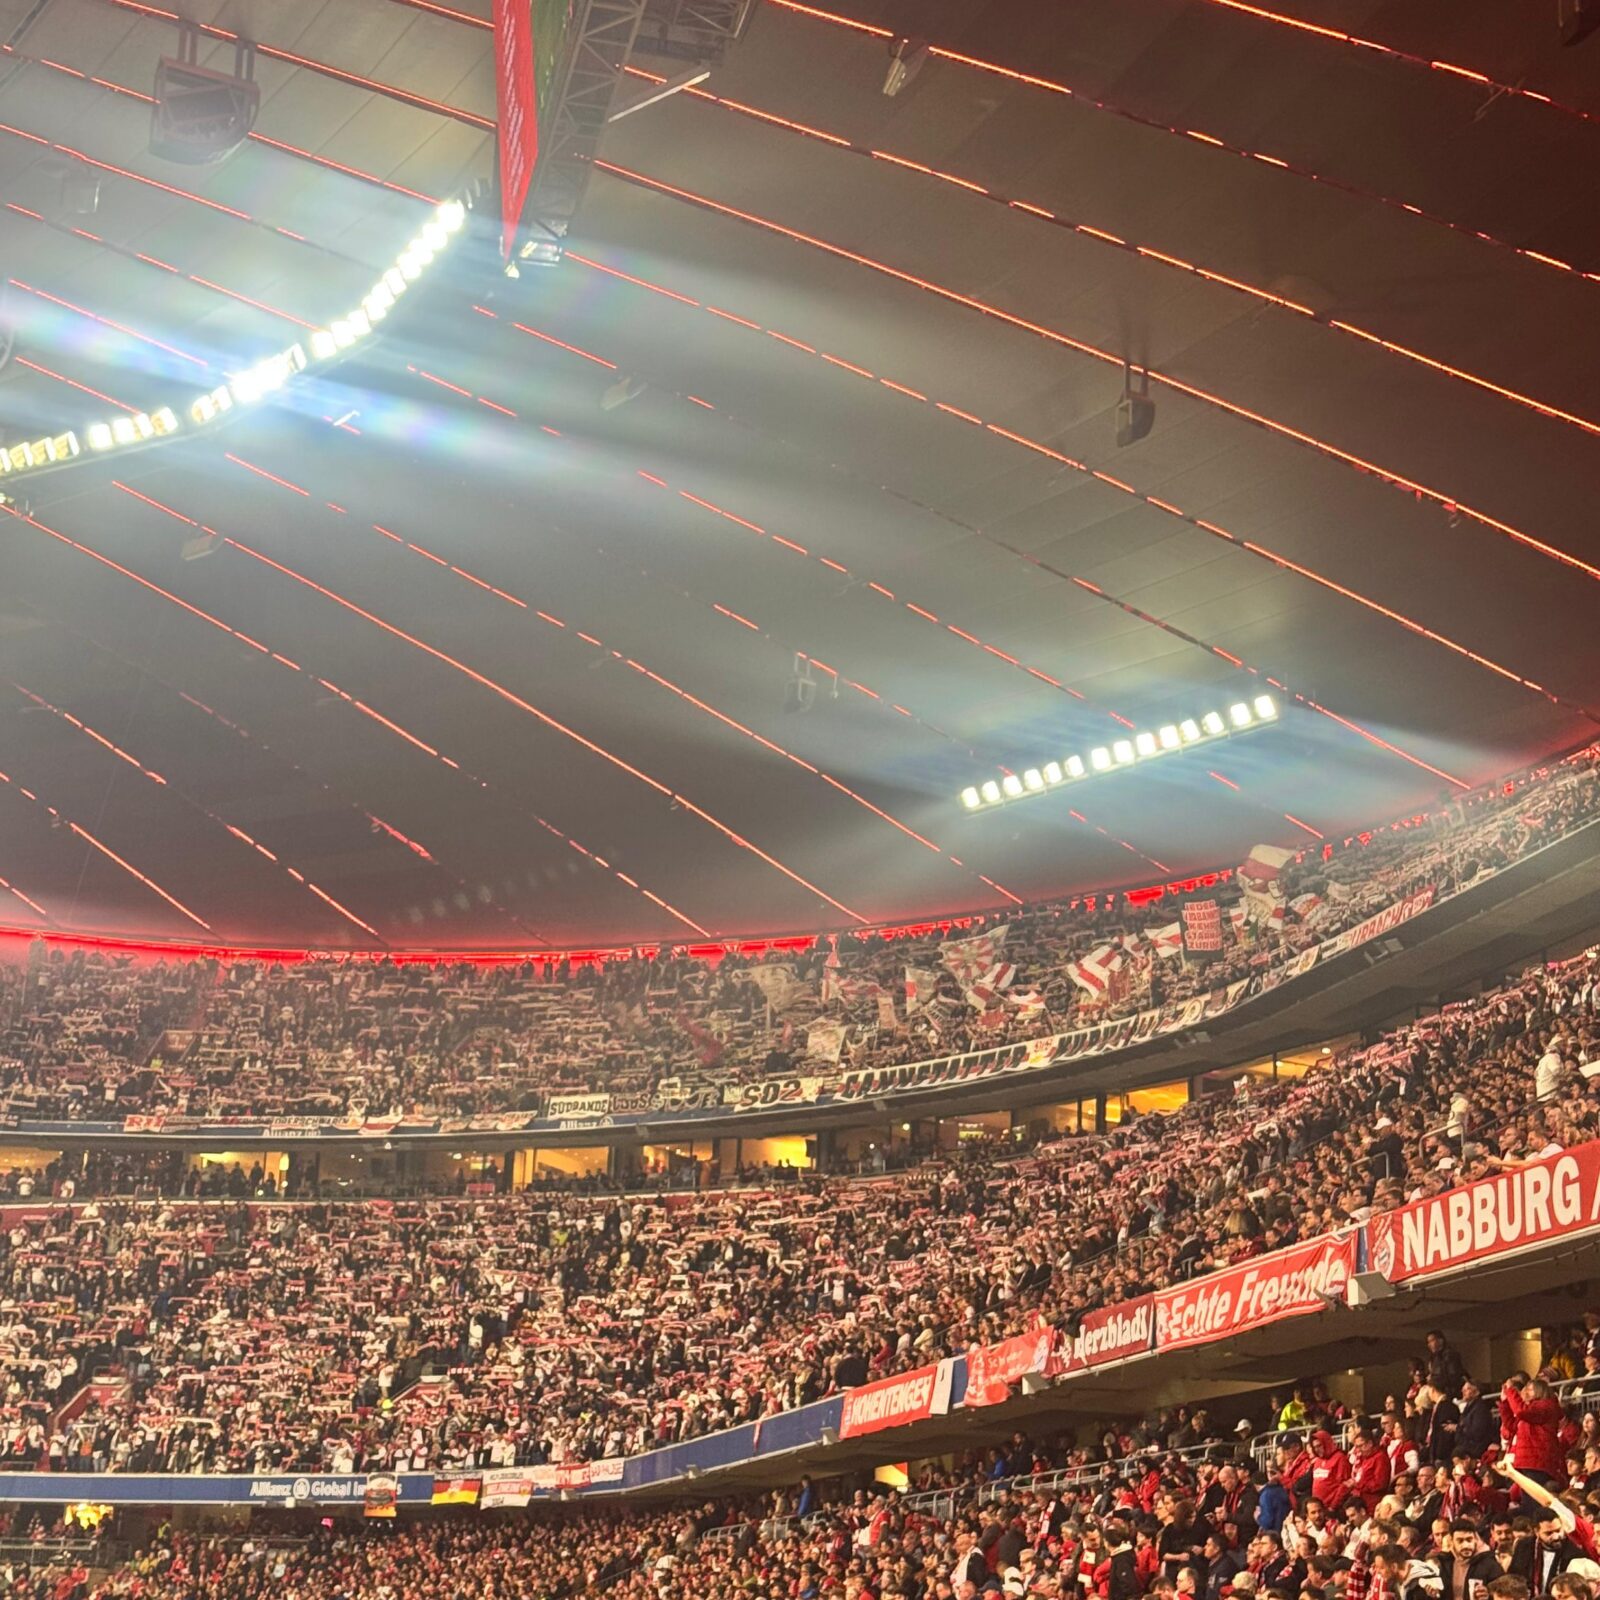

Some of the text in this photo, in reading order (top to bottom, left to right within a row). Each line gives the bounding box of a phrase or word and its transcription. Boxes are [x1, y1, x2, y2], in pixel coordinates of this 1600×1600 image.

[1402, 1156, 1582, 1272] NABBURG
[1168, 1247, 1346, 1340] Echte Freunde
[250, 1481, 292, 1497] Allianz
[311, 1481, 350, 1497] Global
